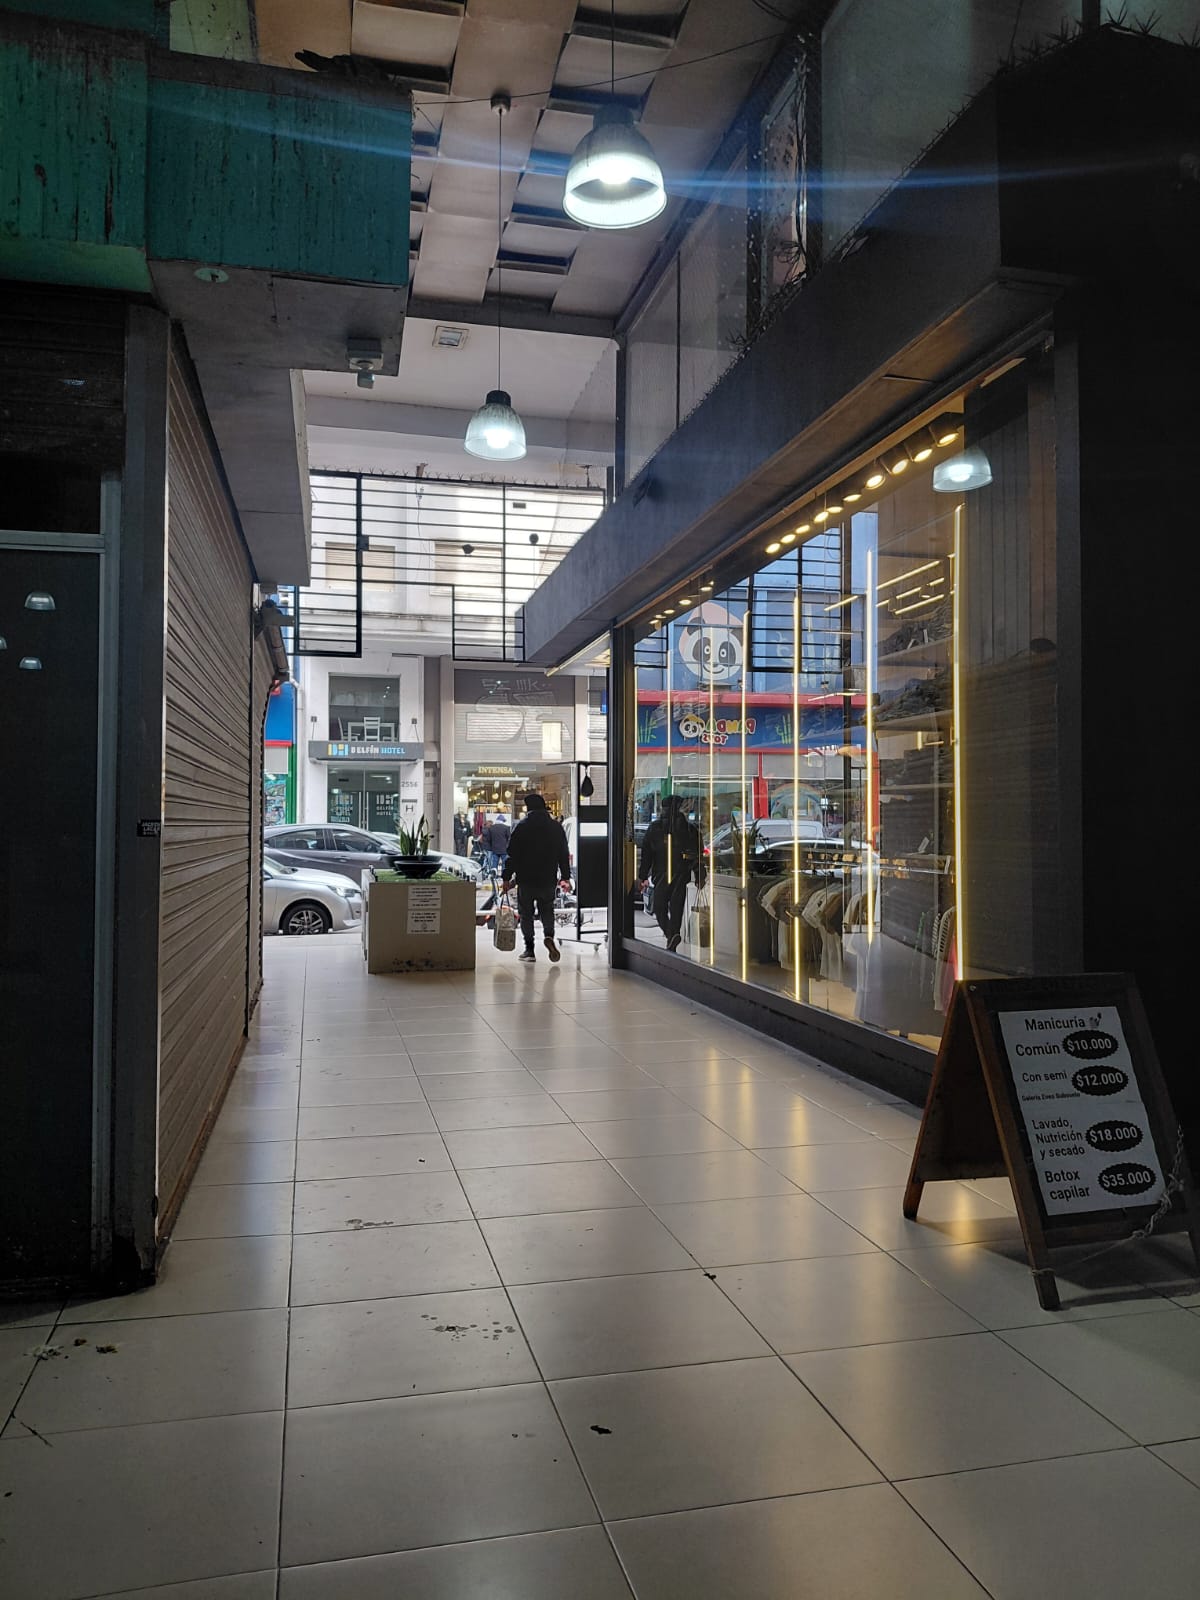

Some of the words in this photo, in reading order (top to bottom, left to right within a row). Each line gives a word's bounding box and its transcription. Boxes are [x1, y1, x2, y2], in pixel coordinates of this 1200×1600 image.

[478, 766, 513, 774] INTENSA
[1025, 1015, 1085, 1031] Manicuría
[1016, 1041, 1061, 1056] Común
[1067, 1038, 1112, 1053] $10.000
[1022, 1072, 1041, 1082] Con
[1045, 1070, 1067, 1081] semi
[1076, 1072, 1123, 1087] $12.000
[1032, 1117, 1073, 1130] Lavado,
[1035, 1130, 1083, 1144] Nutrición
[1089, 1126, 1138, 1143] $18.000
[1039, 1149, 1046, 1160] y
[1049, 1145, 1086, 1157] secado
[1045, 1170, 1081, 1183] Botox
[1102, 1170, 1151, 1188] $35.000
[1050, 1186, 1090, 1202] capilar
